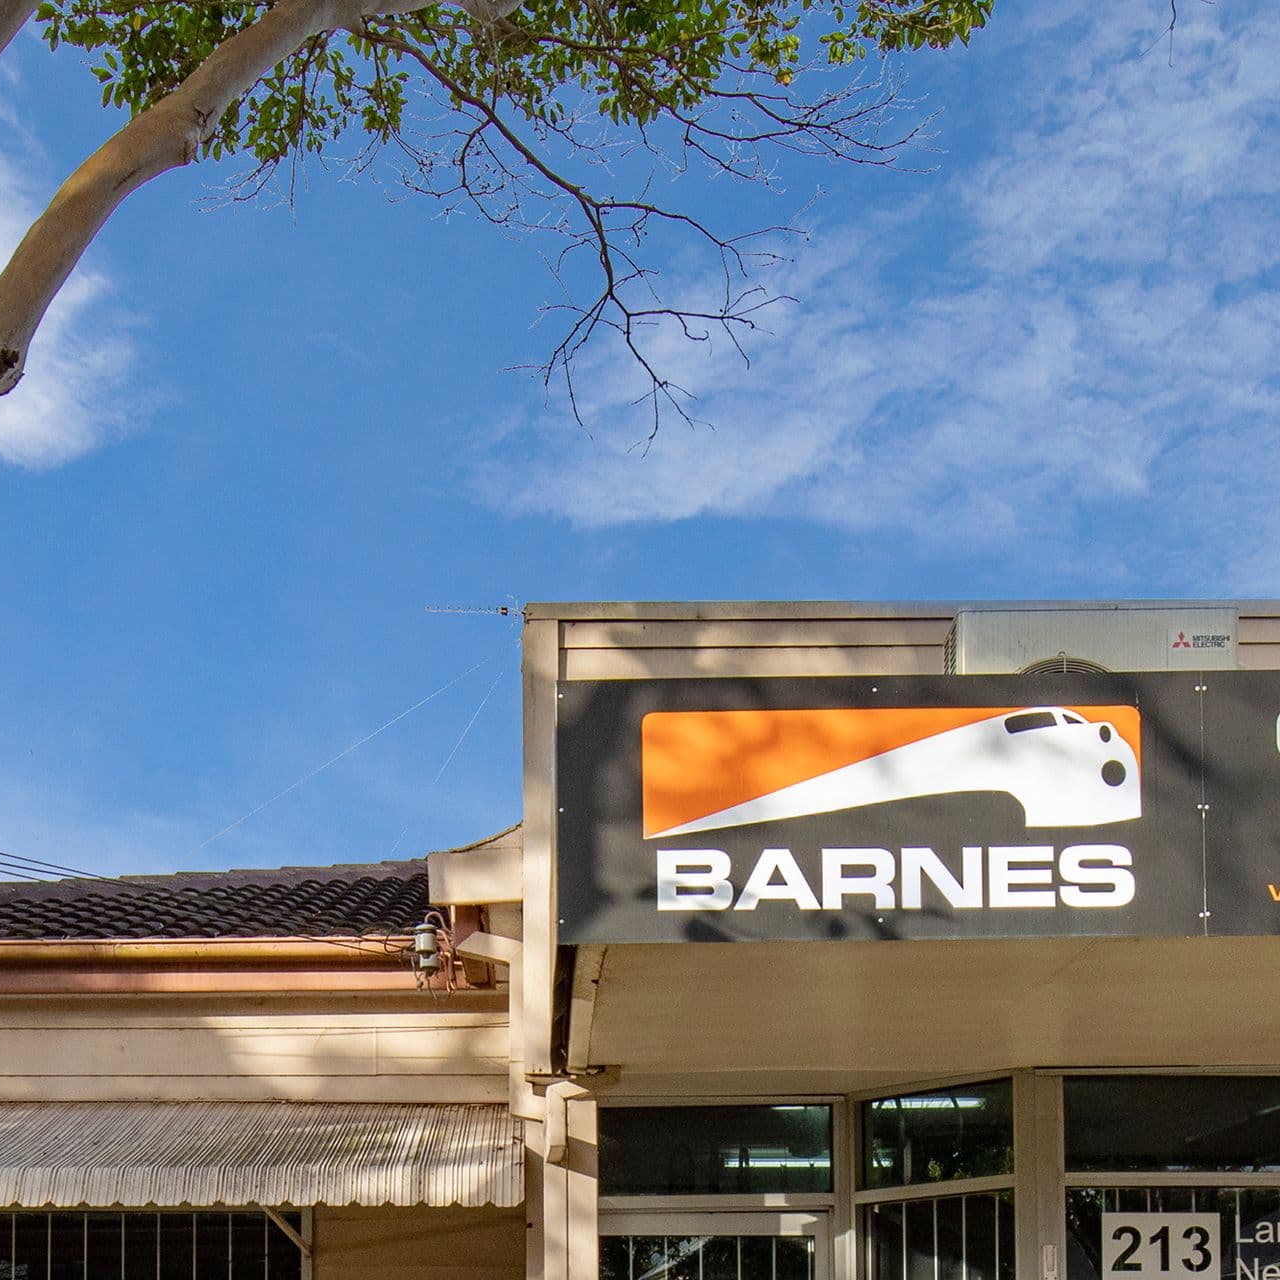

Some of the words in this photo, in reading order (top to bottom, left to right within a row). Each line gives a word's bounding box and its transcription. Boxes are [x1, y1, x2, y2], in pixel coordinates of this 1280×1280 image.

[1192, 641, 1226, 649] ELECTRIC
[656, 844, 1137, 911] BARNES
[1111, 1225, 1212, 1273] 213
